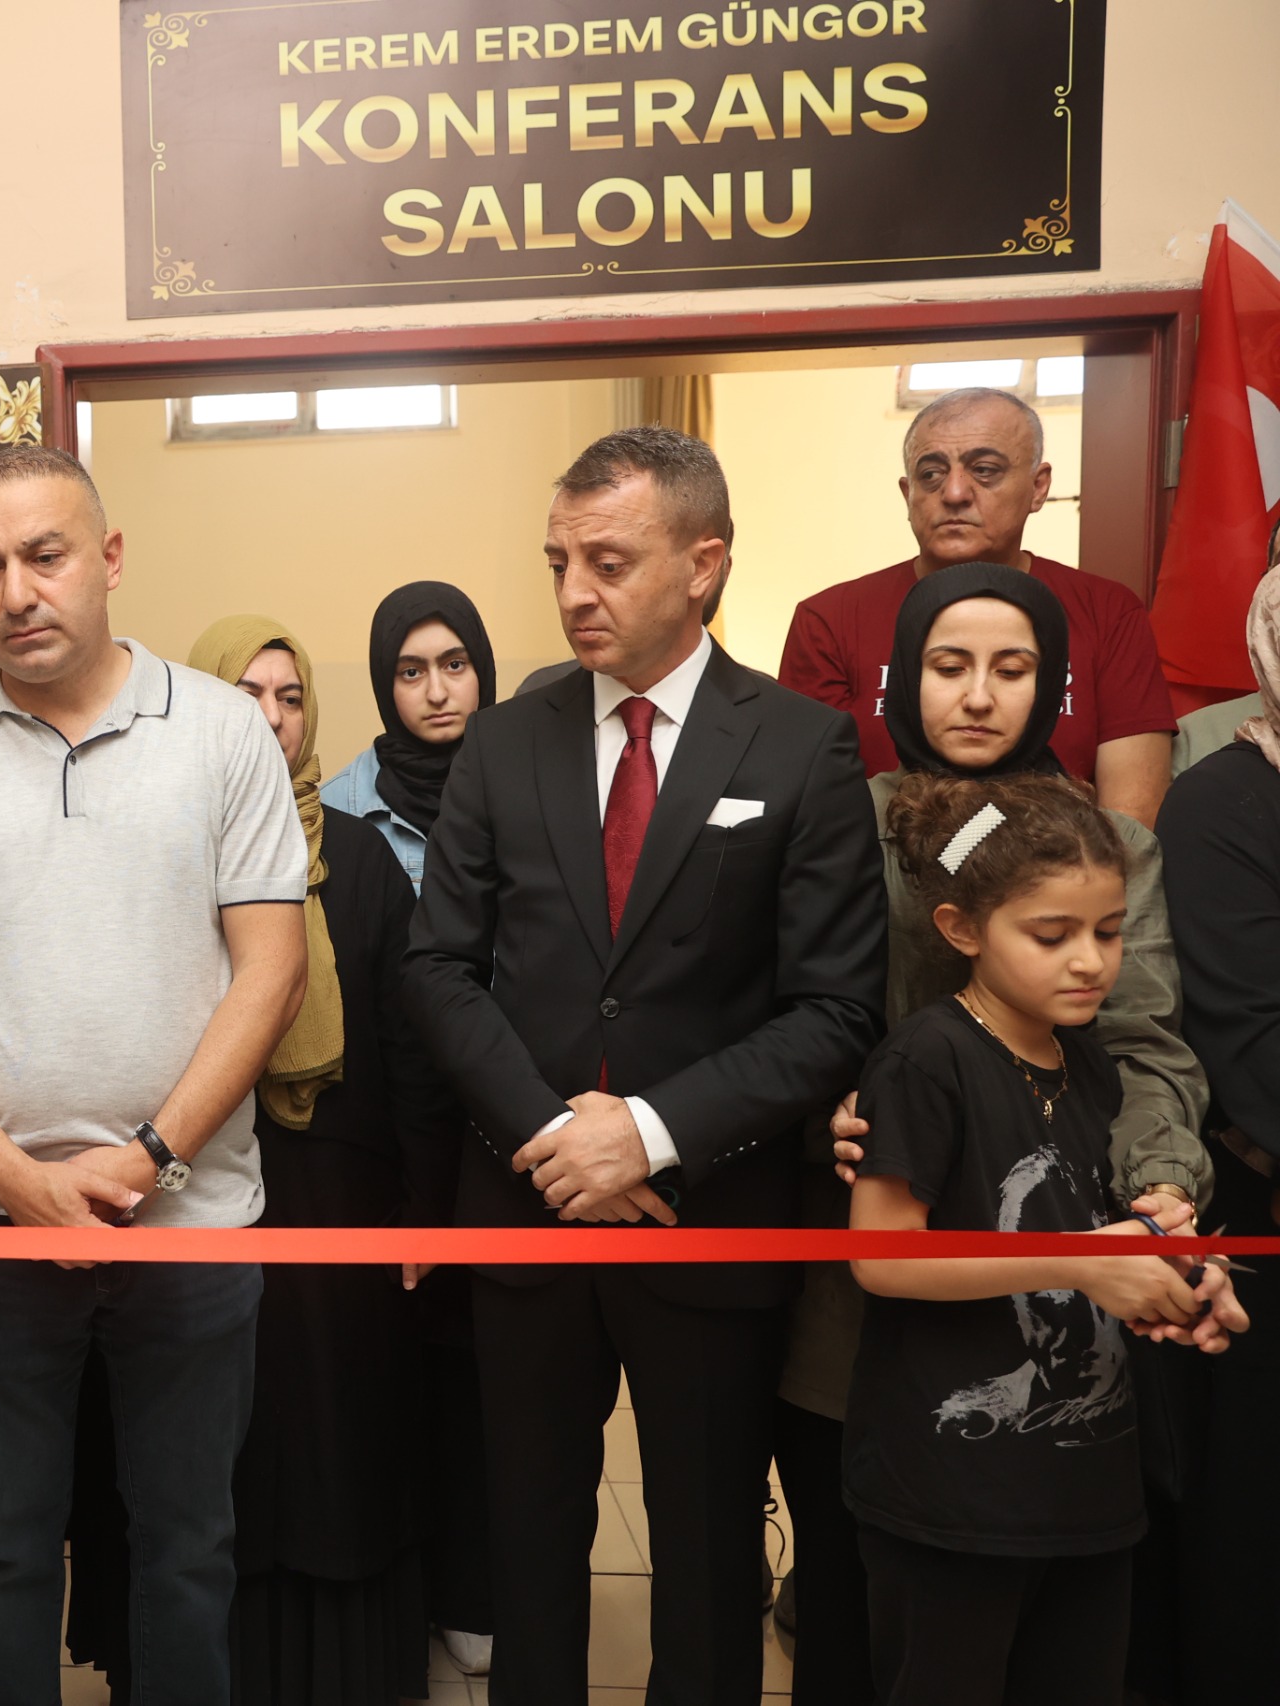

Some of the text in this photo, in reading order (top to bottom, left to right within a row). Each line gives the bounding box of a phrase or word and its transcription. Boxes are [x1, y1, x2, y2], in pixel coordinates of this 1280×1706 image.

[277, 30, 459, 76] KEREM
[475, 16, 663, 63] ERDEM
[278, 62, 928, 168] KONFERANS
[380, 168, 812, 257] SALONU
